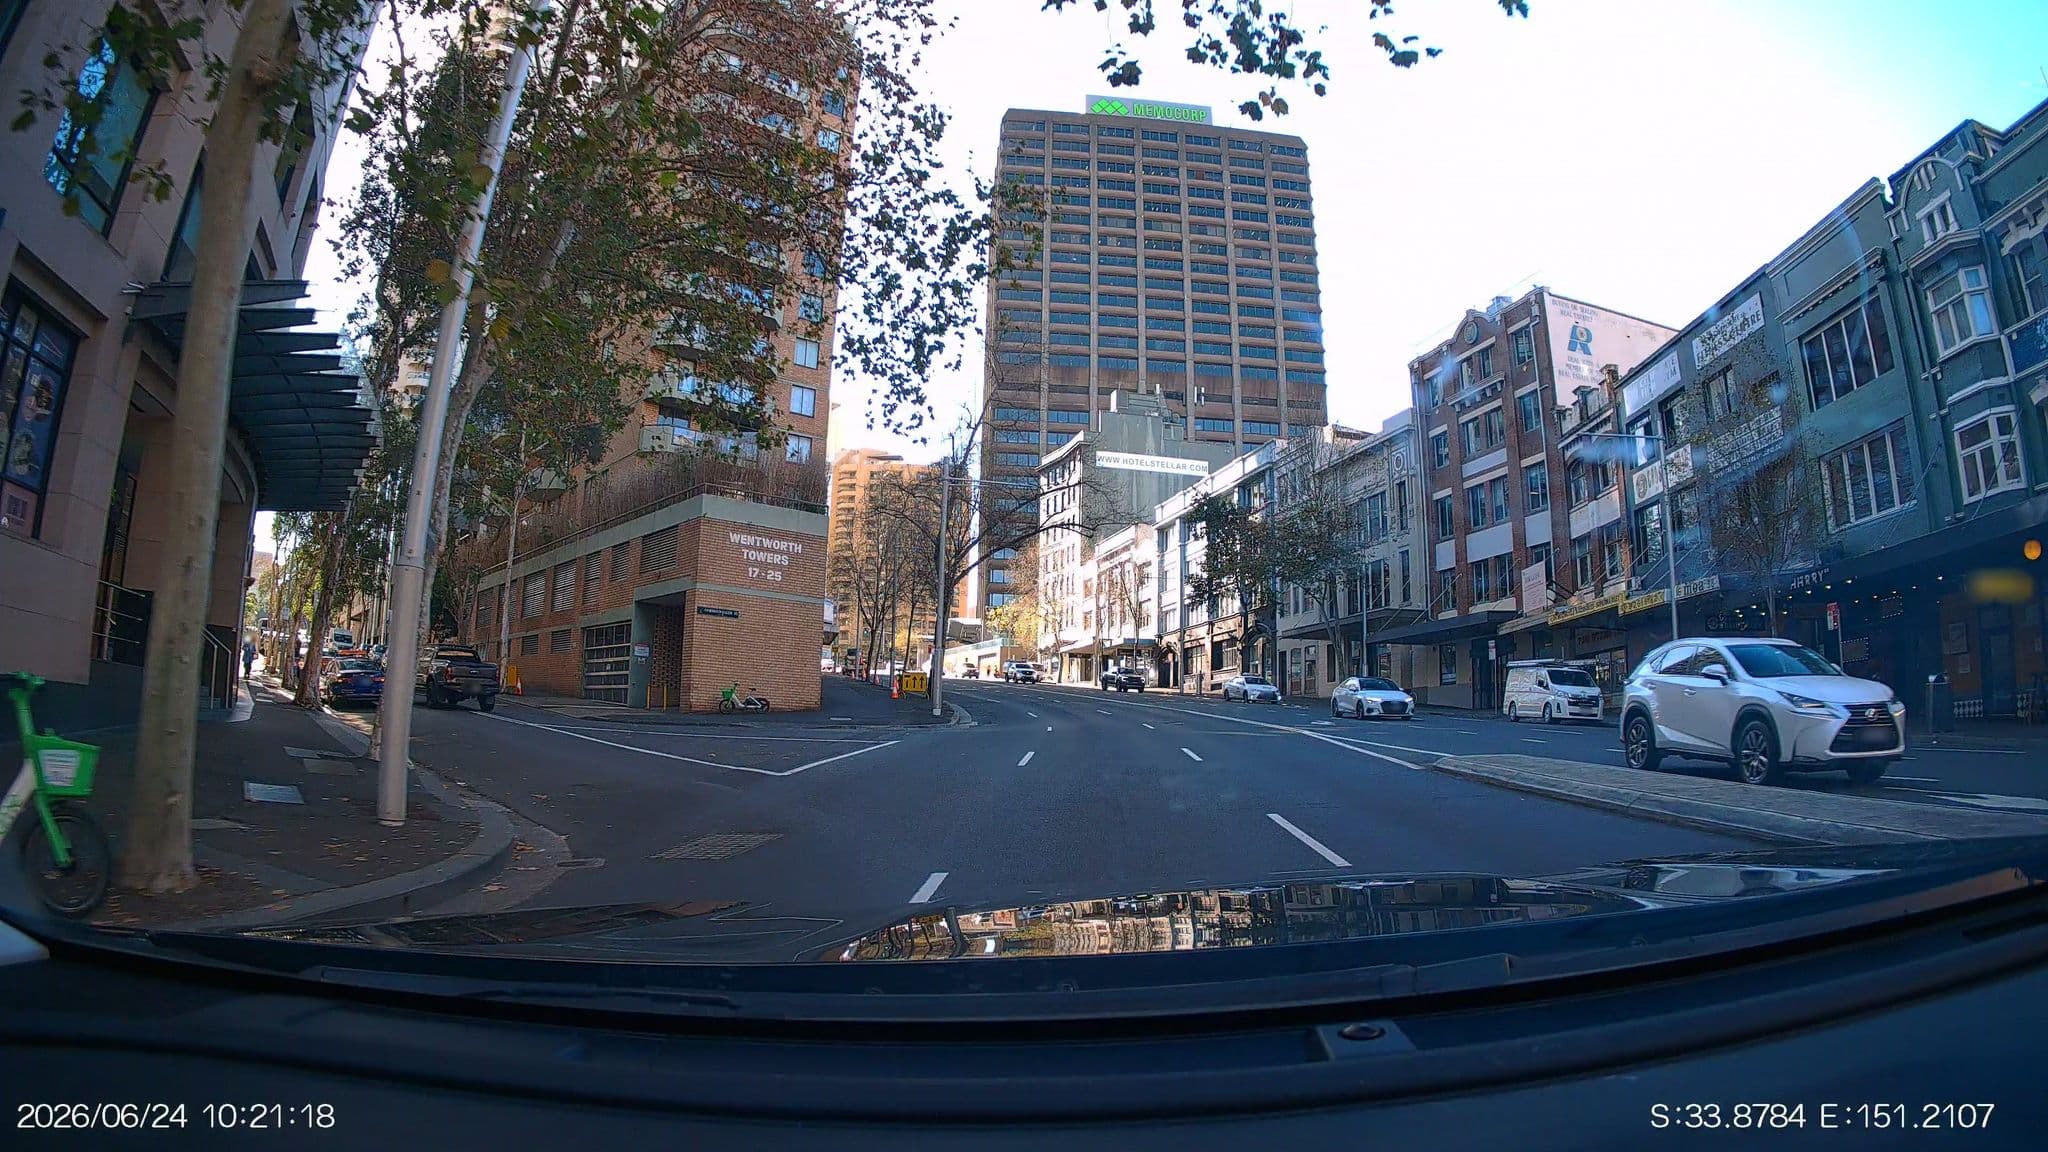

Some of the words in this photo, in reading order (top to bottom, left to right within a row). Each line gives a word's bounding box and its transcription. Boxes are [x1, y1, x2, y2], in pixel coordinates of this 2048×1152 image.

[1132, 103, 1207, 122] MEMOCORP
[729, 531, 802, 554] WENTWORTH
[741, 549, 790, 566] TOWERS
